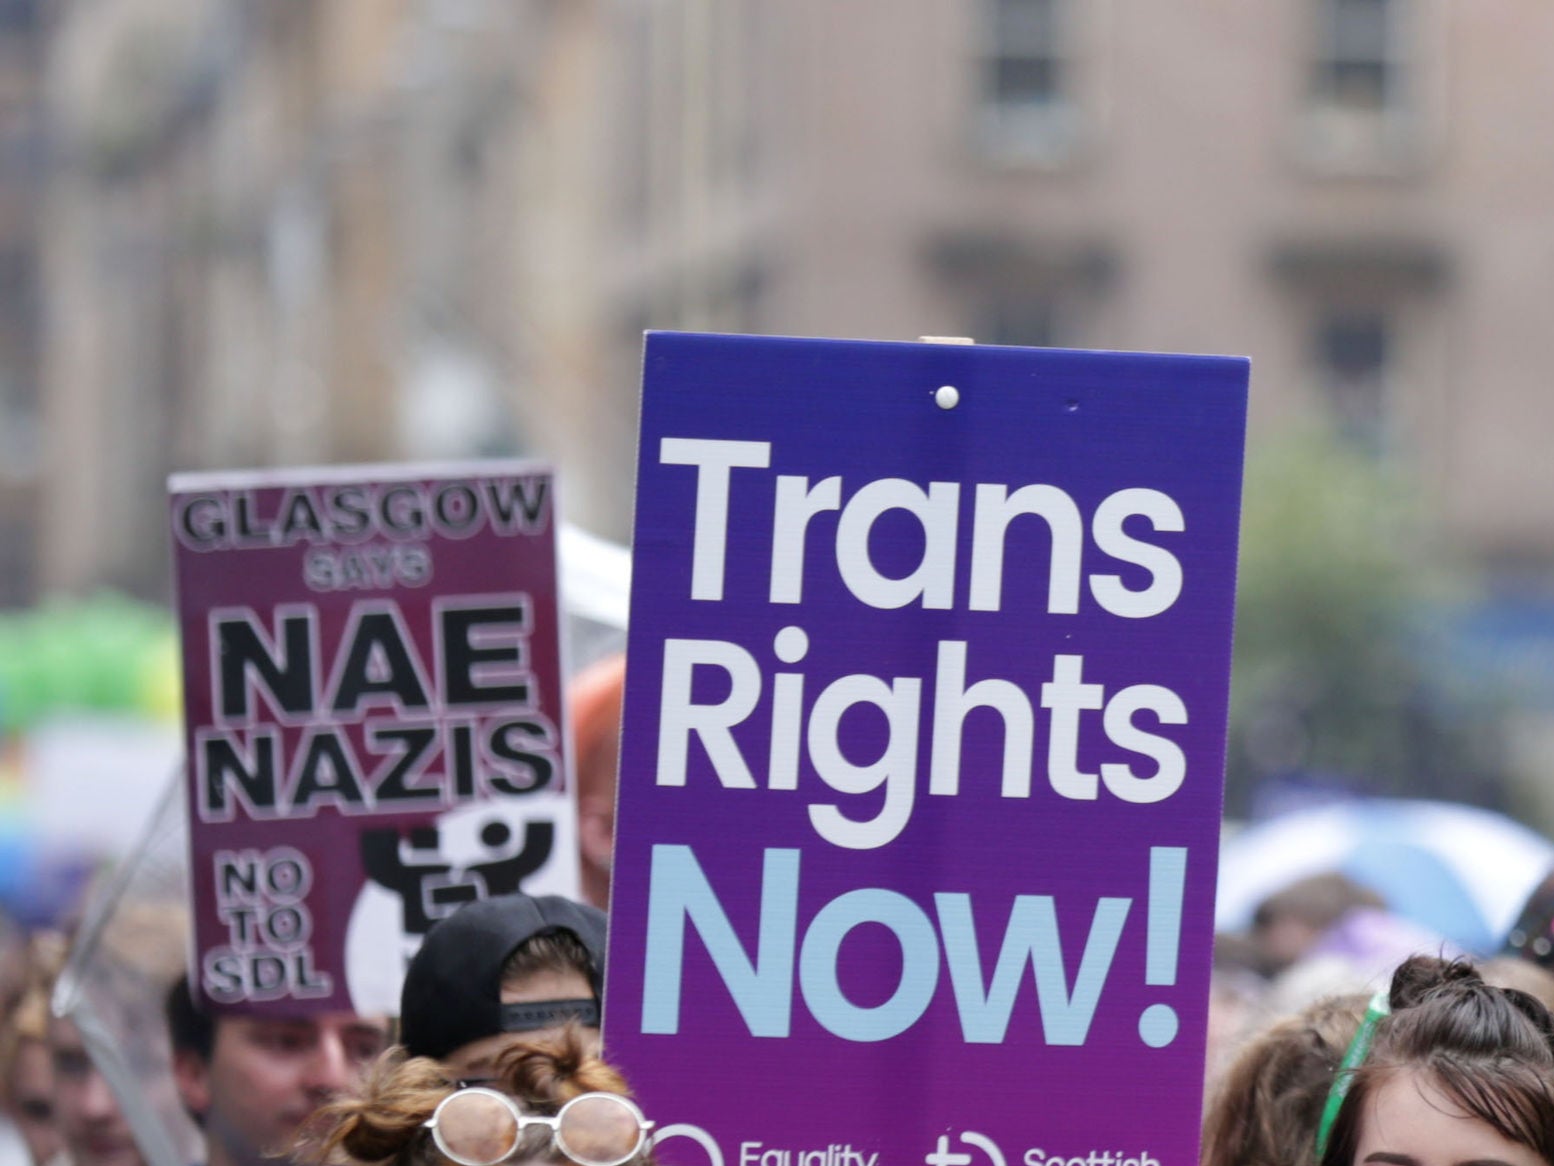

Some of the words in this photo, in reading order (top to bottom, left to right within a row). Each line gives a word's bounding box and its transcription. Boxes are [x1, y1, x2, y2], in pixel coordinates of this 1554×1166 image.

[179, 473, 549, 546] GLASGOW
[660, 438, 1186, 619] Trans
[306, 546, 429, 589] SAYS
[216, 602, 530, 718] NAE
[203, 718, 555, 812] NAZIS
[655, 626, 1188, 851] Rights
[220, 853, 308, 902] NO
[227, 905, 306, 948] TO
[642, 844, 1188, 1049] Now!
[207, 950, 329, 998] SDL
